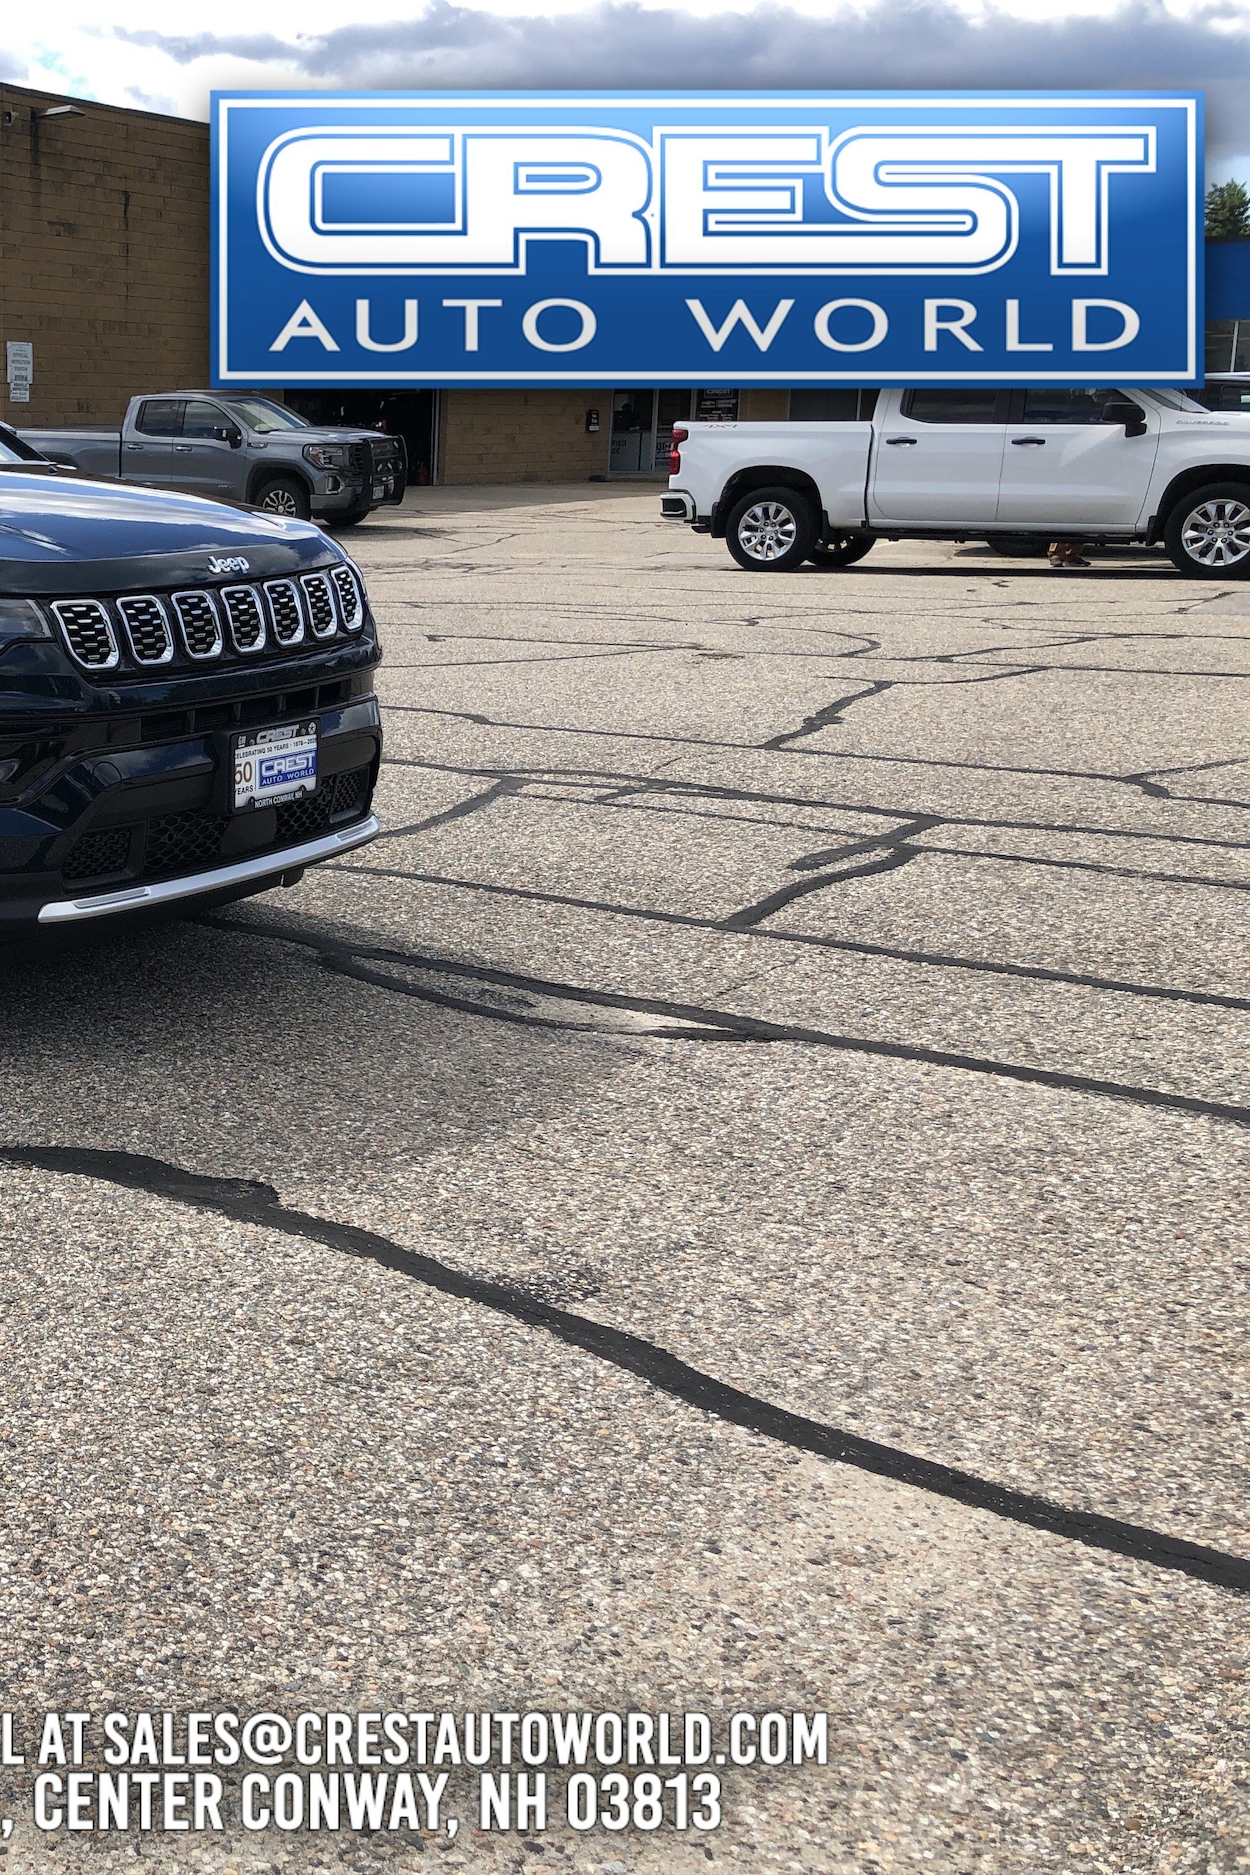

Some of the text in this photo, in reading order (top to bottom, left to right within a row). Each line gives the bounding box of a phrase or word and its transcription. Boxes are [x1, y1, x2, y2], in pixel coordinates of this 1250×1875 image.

[208, 555, 250, 575] Jeep
[256, 724, 300, 744] CREST
[273, 742, 289, 752] YEARS
[261, 753, 316, 777] CREST
[261, 768, 315, 786] AUTO WORLD
[255, 797, 273, 808] NORTH
